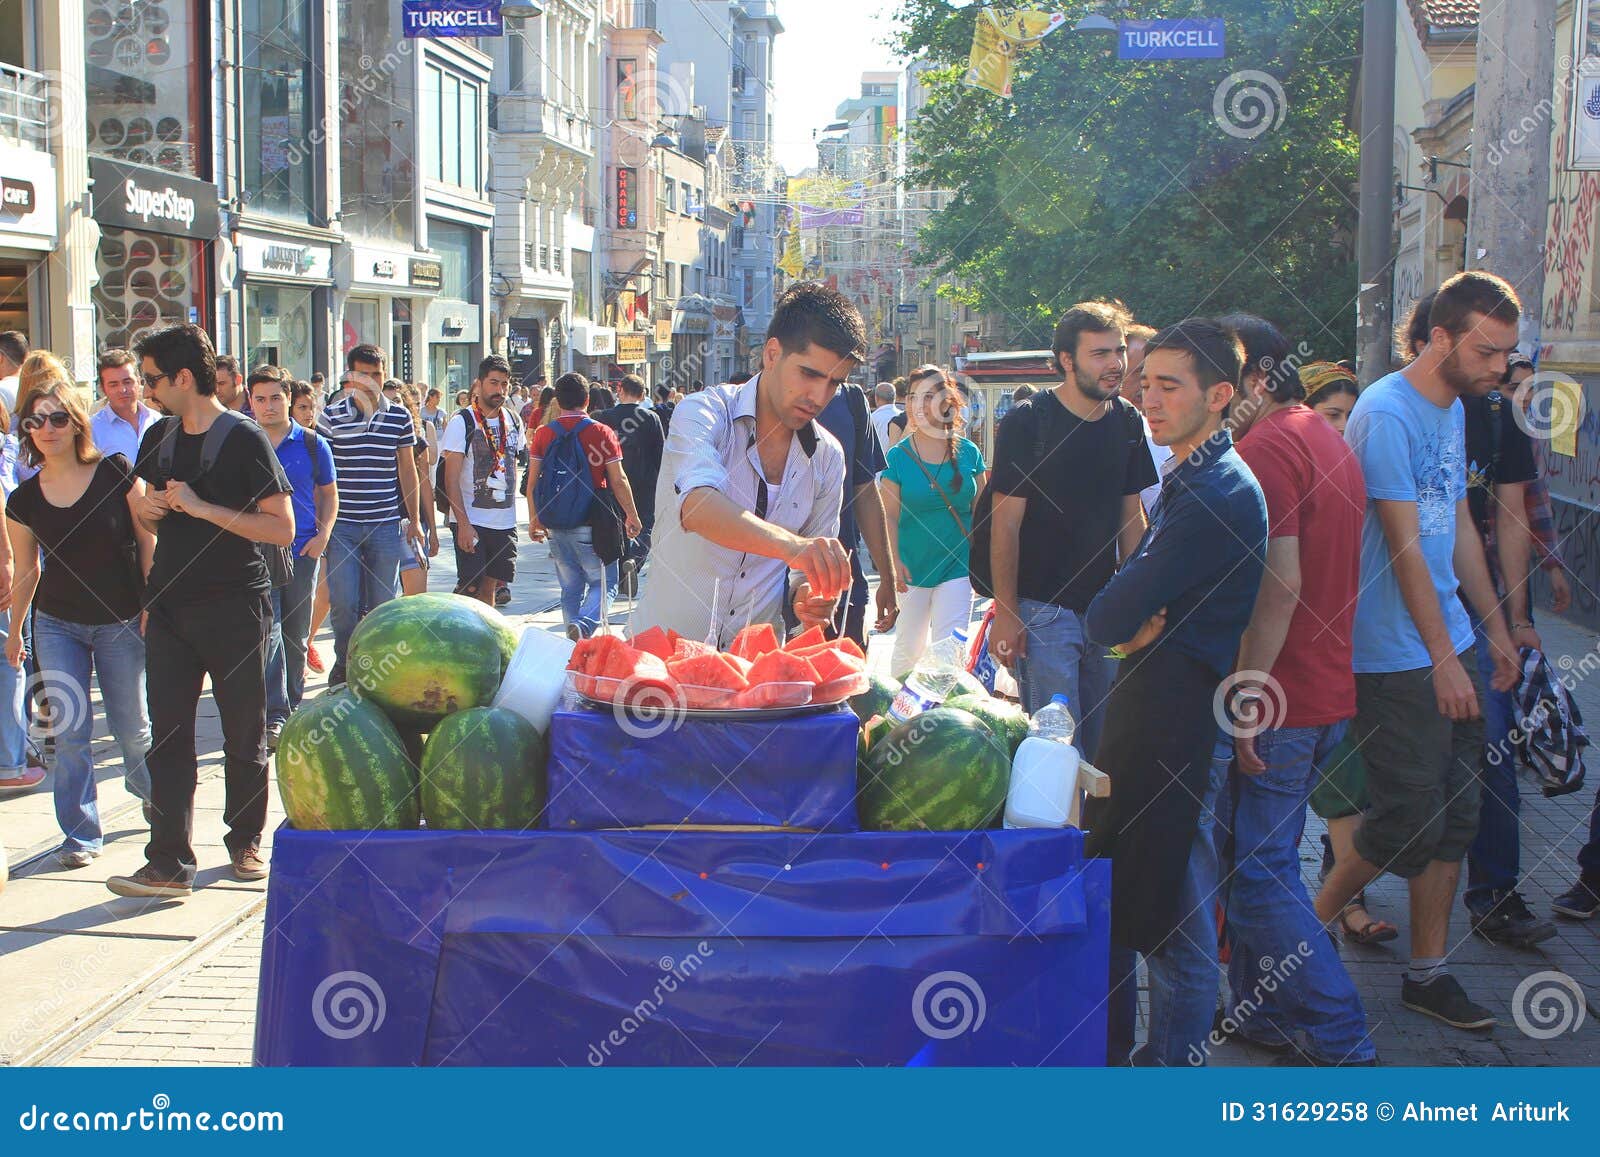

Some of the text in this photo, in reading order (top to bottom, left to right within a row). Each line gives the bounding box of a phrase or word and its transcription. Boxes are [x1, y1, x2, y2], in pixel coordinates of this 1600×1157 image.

[407, 10, 498, 27] TURKCELL
[1124, 30, 1219, 48] TURKCELL
[3, 187, 29, 205] CAFE
[125, 179, 195, 229] SuperStep
[618, 169, 628, 226] CHANGE
